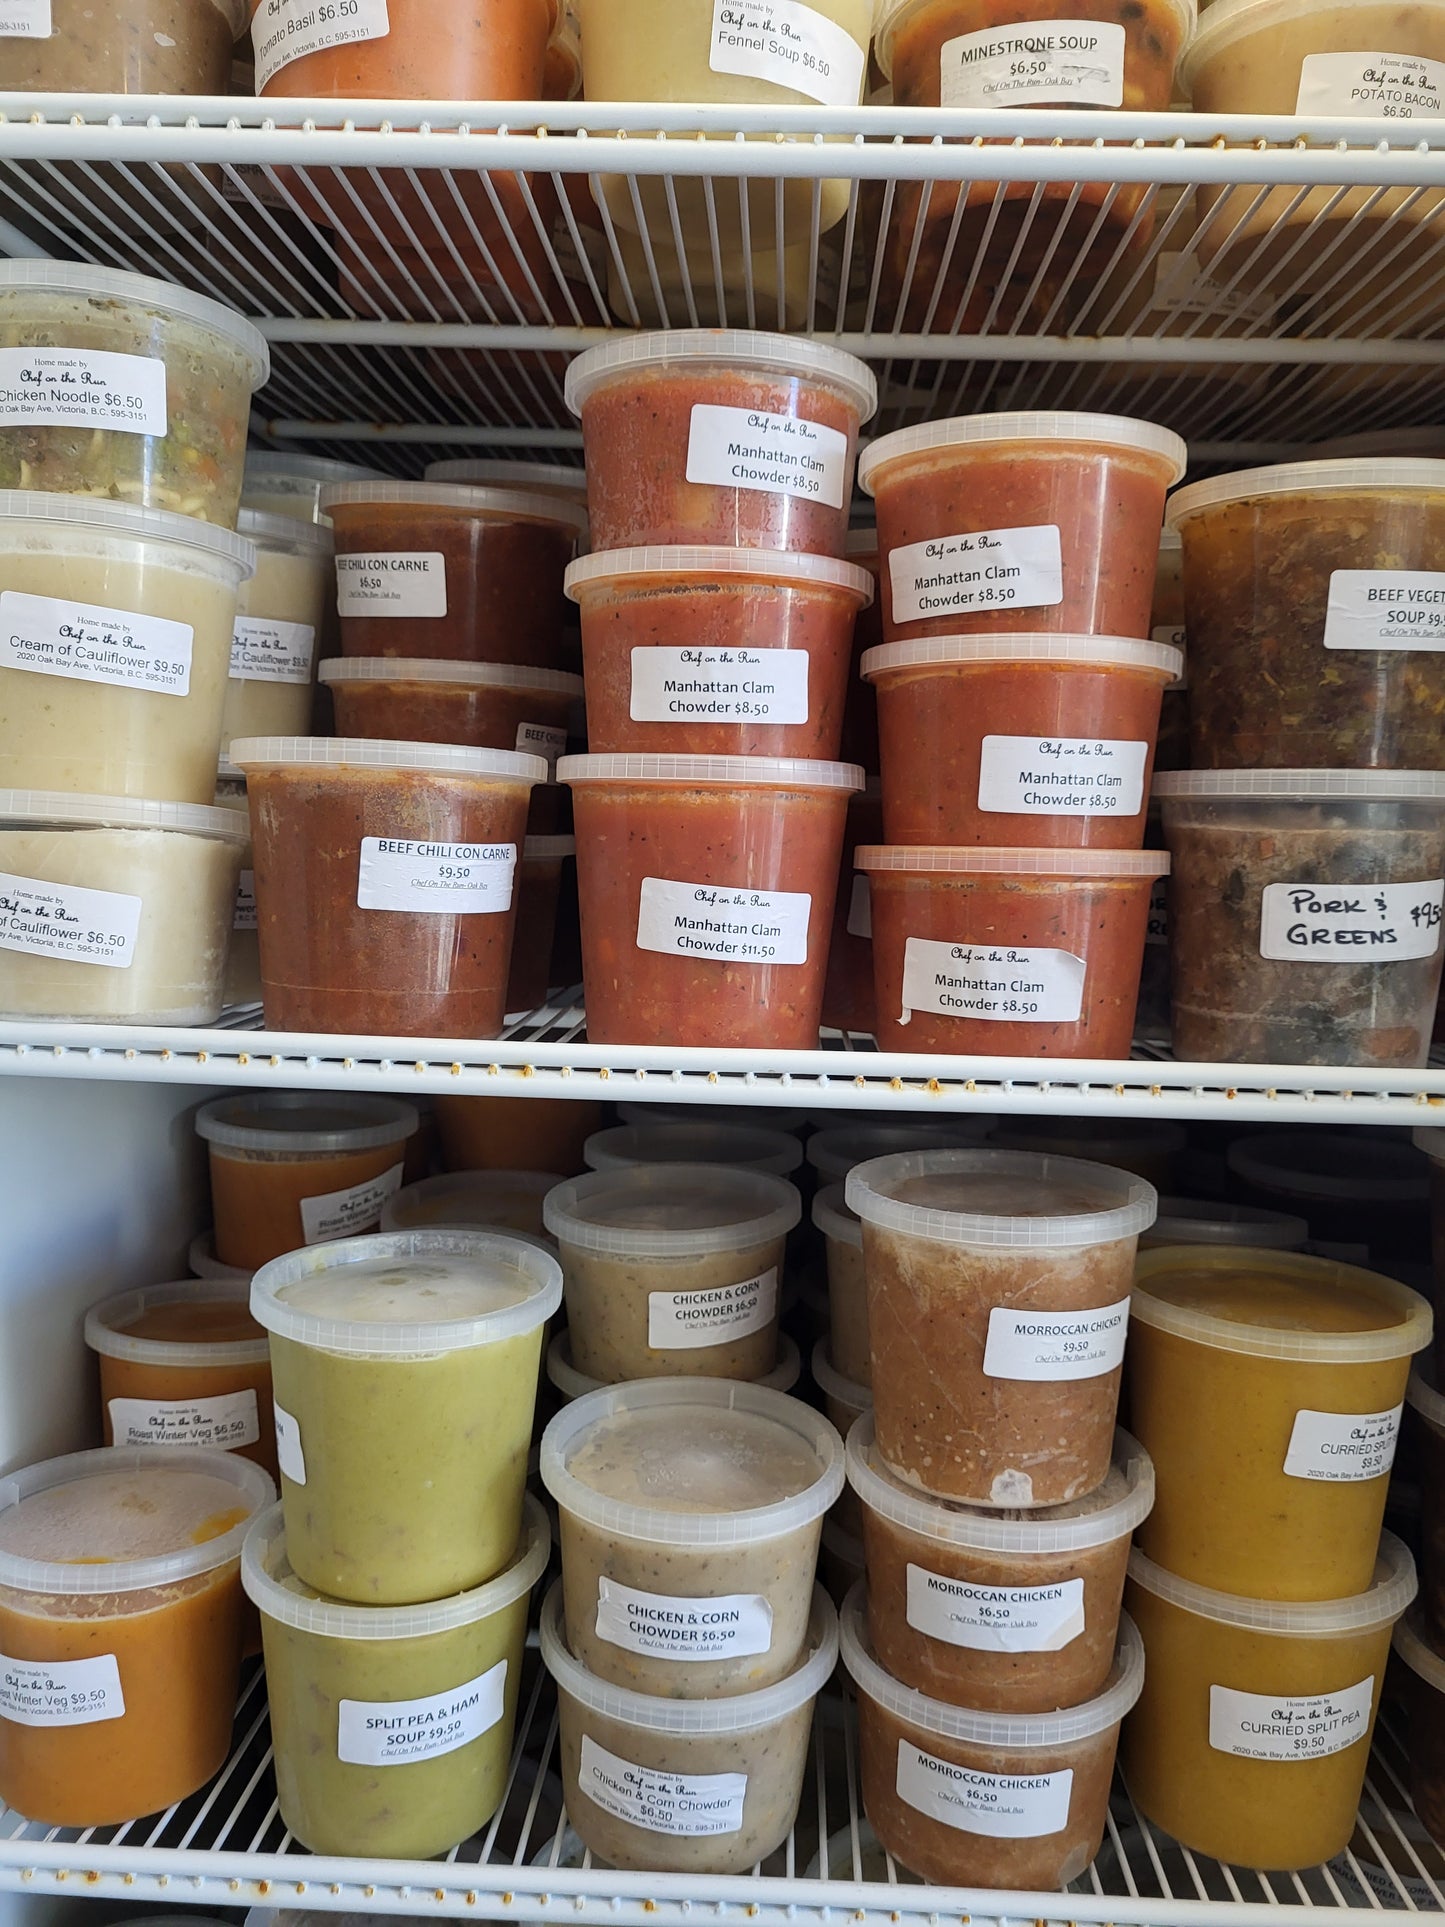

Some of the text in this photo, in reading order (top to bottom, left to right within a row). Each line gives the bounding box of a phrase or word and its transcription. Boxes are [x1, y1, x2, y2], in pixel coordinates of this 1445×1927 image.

[260, 0, 358, 61] Tomato Basil $6.50
[720, 10, 745, 30] Chef
[762, 19, 776, 33] the
[781, 23, 801, 42] Run
[718, 31, 830, 76] Fennel Soup $6.50
[961, 36, 1098, 64] MINESTRONE SOUP
[1010, 61, 1047, 76] $6.50
[1351, 89, 1440, 110] POTATO BACON
[1383, 105, 1412, 118] $6.50
[79, 360, 88, 368] by
[20, 370, 42, 386] Chef
[61, 372, 76, 383] the
[81, 372, 107, 386] Run
[0, 390, 143, 409] Chicken Noodle $6.50
[21, 405, 35, 414] Bay
[56, 406, 88, 415] Victoria,
[91, 408, 108, 416] B.C.
[111, 410, 147, 420] 595-3151
[728, 443, 825, 473] Manhattan Clam
[732, 465, 819, 492] Chowder $8.50
[348, 559, 366, 570] CHILI
[368, 560, 388, 570] CON
[391, 560, 429, 571] CARNE
[914, 565, 1020, 590] Manhattan Clam
[918, 588, 1015, 610] Chowder $8.50
[1368, 588, 1404, 600] BEEF
[77, 617, 130, 632] Home made by
[1387, 611, 1445, 627] SOUP $9.
[59, 625, 83, 644] Chef
[103, 633, 118, 645] the
[123, 635, 146, 651] Run
[9, 635, 184, 676] Cream of Cauliflower $9.50
[681, 650, 702, 667] Chef
[720, 652, 734, 663] the
[738, 651, 760, 663] Run
[16, 652, 35, 661] 2020
[38, 655, 53, 664] Oak
[56, 658, 71, 668] Bay
[94, 664, 125, 676] Victoria,
[128, 669, 143, 679] B.C.
[145, 672, 177, 684] 595-3151
[664, 680, 775, 694] Manhattan Clam
[669, 701, 769, 716] Chowder $8.50
[525, 729, 545, 742] BEEF
[1019, 772, 1122, 787] Manhattan Clam
[1024, 793, 1117, 808] Chowder $8.50
[379, 840, 510, 859] BEEF CHILI CON CARNE
[439, 865, 470, 879] $9.50
[694, 889, 717, 906] Chef
[734, 895, 746, 906] the
[750, 894, 770, 907] Run
[1288, 889, 1367, 913] PORK
[0, 916, 125, 946] of Cauliflower $6.50
[675, 916, 781, 936] Manhattan Clam
[1287, 923, 1398, 945] GREENS
[677, 936, 775, 957] Chowder $11.50
[951, 947, 972, 964] Chef
[989, 952, 1002, 962] the
[1007, 951, 1030, 963] Run
[935, 974, 1044, 993] Manhattan Clam
[939, 994, 1038, 1014] Chowder $8.50
[673, 1280, 760, 1304] CHICKEN & CORN
[676, 1297, 757, 1320] CHOWDER $6.50
[1014, 1314, 1122, 1335] MORROCCAN CHICKEN
[1063, 1341, 1088, 1352] $9.50
[128, 1427, 153, 1439] Roast
[154, 1429, 187, 1439] Winter
[190, 1429, 212, 1439] Veg
[1320, 1443, 1372, 1455] CURRIED
[928, 1578, 1062, 1602] MORROCCAN CHICKEN
[628, 1604, 739, 1624] CHICKEN & CORN
[979, 1607, 1010, 1618] $6.50
[629, 1621, 735, 1641] CHOWDER $6.50
[13, 1689, 106, 1707] Winter Veg $9.50
[366, 1693, 480, 1729] SPLIT PEA & HAM
[1241, 1710, 1360, 1735] CURRIED SPLIT PEA
[387, 1720, 461, 1745] SOUP $9.50
[1293, 1736, 1325, 1750] $9.50
[918, 1755, 1050, 1789] MORROCCAN CHICKEN
[592, 1767, 731, 1811] Chicken & Corn Chowder
[967, 1789, 998, 1802] $6.50
[640, 1804, 673, 1822] $6.50
